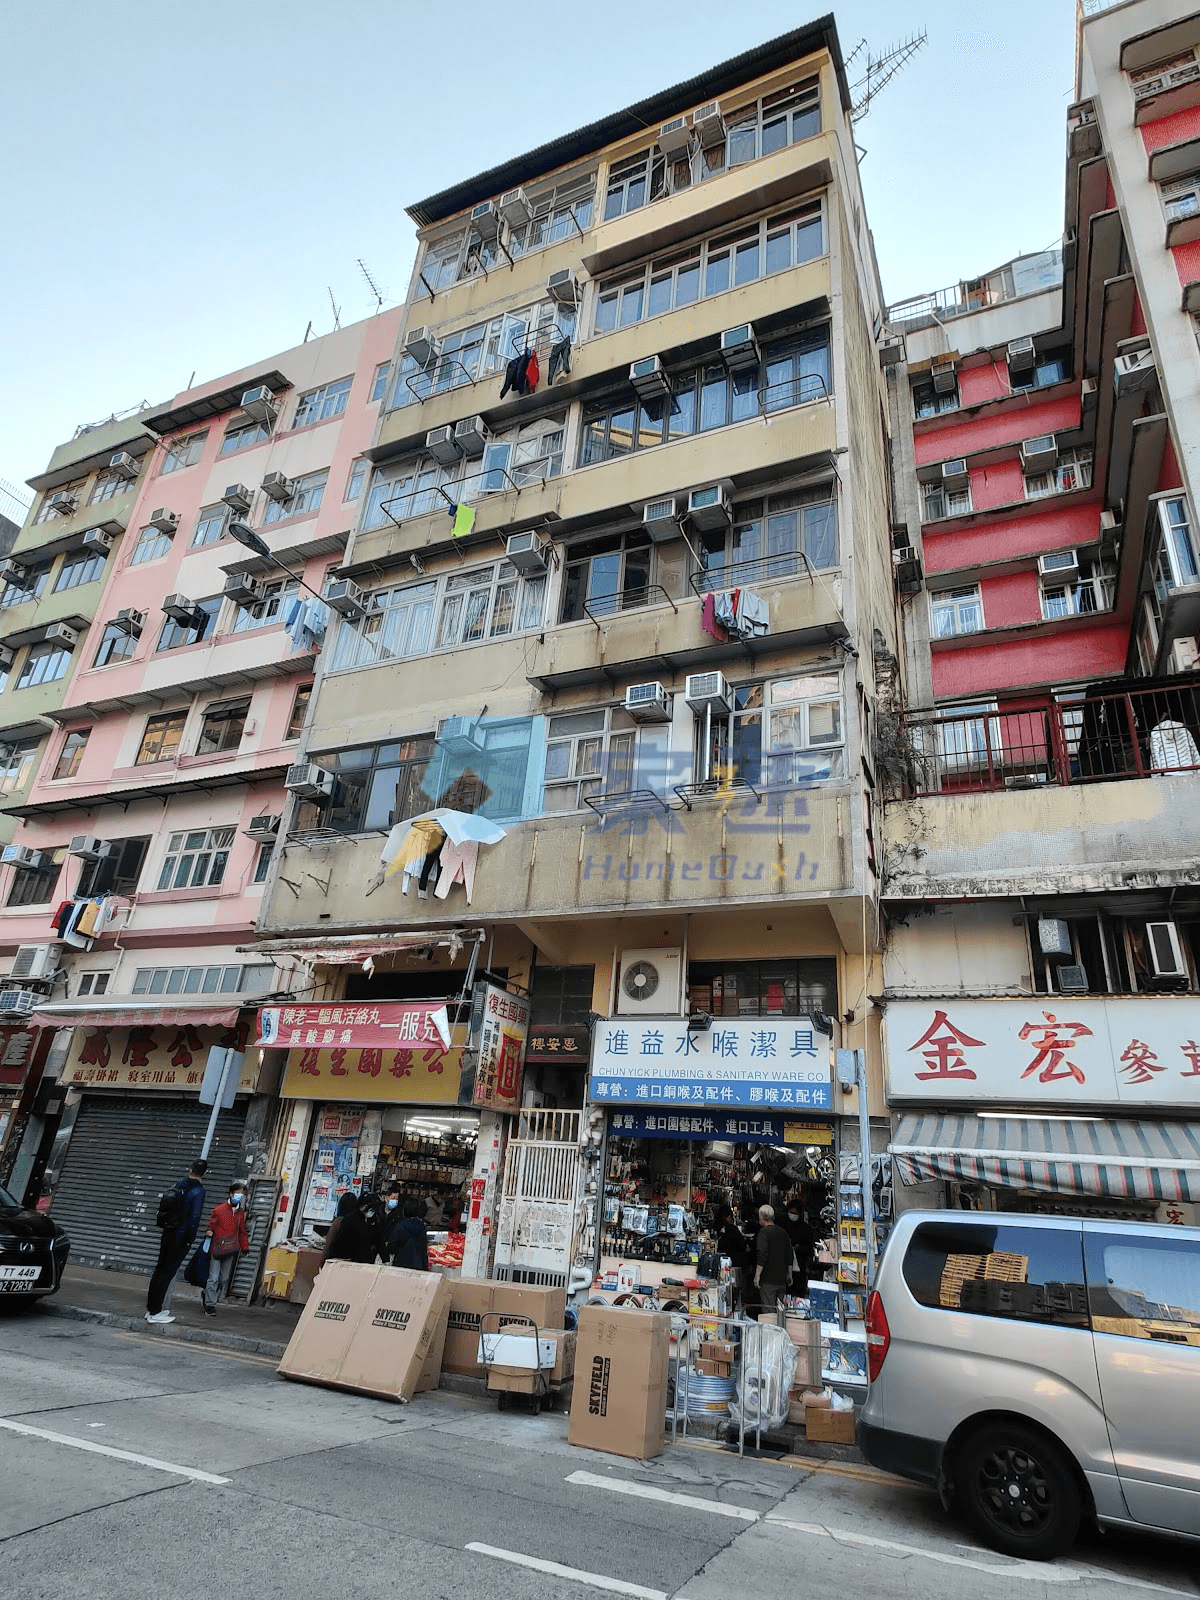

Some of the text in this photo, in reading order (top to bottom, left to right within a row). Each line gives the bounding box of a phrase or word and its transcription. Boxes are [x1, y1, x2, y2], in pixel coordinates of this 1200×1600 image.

[604, 1029, 819, 1059] 進益水喉潔具
[907, 1009, 1094, 1085] 金宏
[598, 1067, 828, 1082] CHUN YICK PLUMBING & SANITARY WARE CO.
[17, 1268, 36, 1278] 448
[317, 1300, 351, 1314] SKYFIELD
[375, 1308, 411, 1323] SKYFIELD
[448, 1310, 481, 1324] SKYFIELD
[588, 1355, 604, 1415] SKYFIELD
